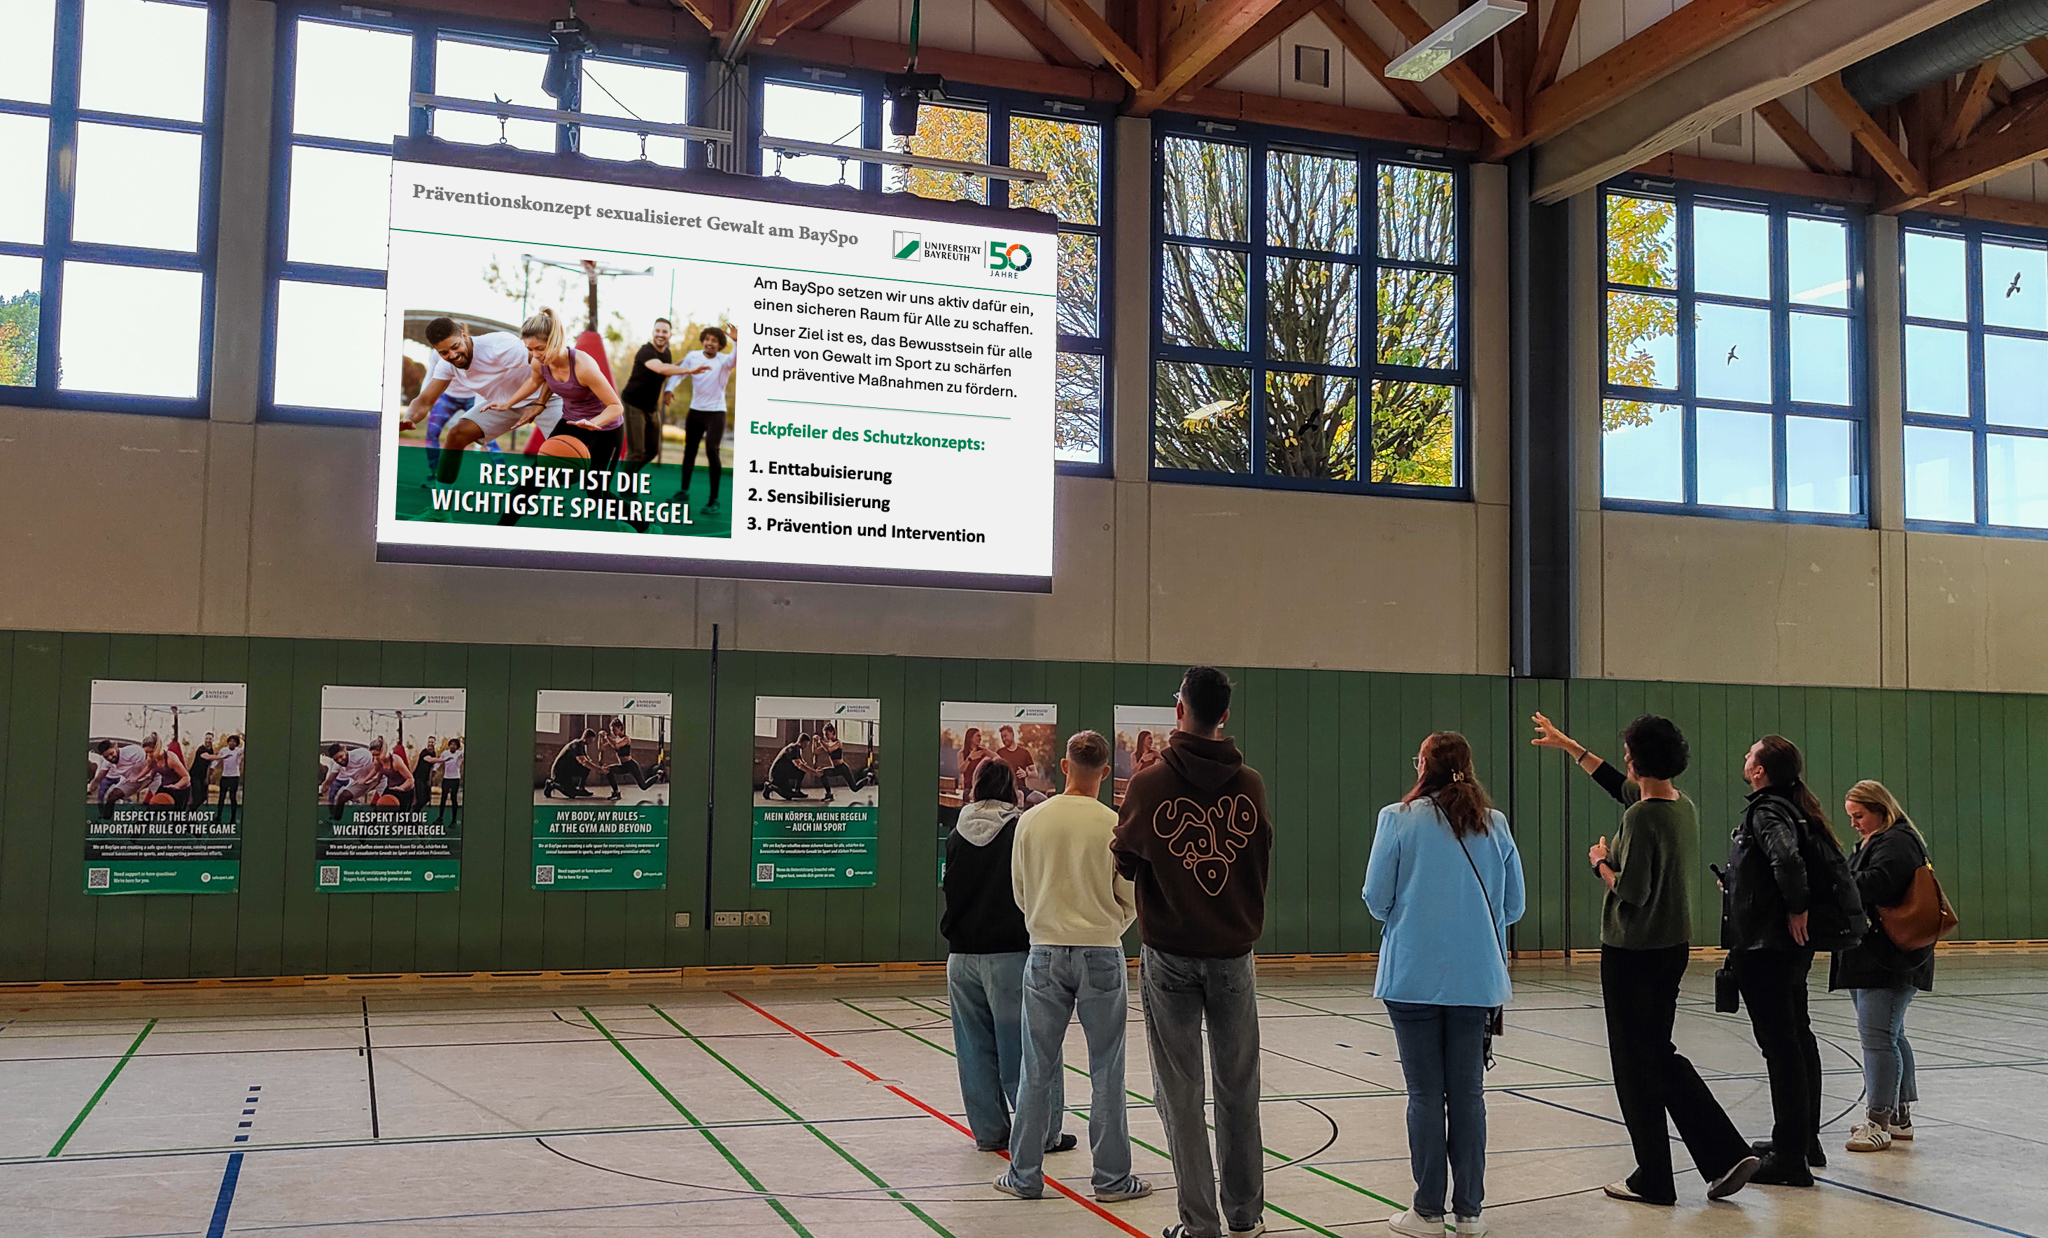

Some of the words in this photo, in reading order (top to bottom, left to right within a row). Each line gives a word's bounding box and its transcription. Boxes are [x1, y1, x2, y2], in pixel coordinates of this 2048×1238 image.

[412, 183, 591, 219] Präventionskonzept
[596, 208, 701, 228] sexualisieret
[706, 216, 764, 234] Gewalt
[768, 226, 794, 238] am
[798, 226, 858, 247] BaySpo
[924, 242, 981, 254] UNIVERSITÄT
[924, 250, 970, 262] BAYREUTH
[990, 241, 1032, 271] 50
[990, 270, 1018, 279] JAHRE
[754, 276, 777, 289] Am
[782, 279, 834, 296] BaySpo
[838, 287, 882, 300] setzen
[886, 290, 906, 302] wir
[910, 294, 934, 305] uns
[938, 295, 969, 308] aktiv
[972, 298, 1006, 312] dafür
[1010, 302, 1033, 316] ein,
[754, 298, 792, 312] einen
[796, 302, 855, 318] sicheren
[860, 307, 899, 322] Raum
[903, 311, 922, 324] für
[924, 314, 950, 327] Alle
[953, 319, 968, 328] zu
[972, 320, 1032, 334] schaffen.
[753, 322, 795, 337] Unser
[798, 326, 823, 340] Ziel
[827, 329, 843, 342] ist
[847, 334, 866, 346] es,
[871, 334, 895, 346] das
[899, 336, 983, 354] Bewusstsein
[987, 344, 1005, 356] für
[1008, 346, 1032, 359] alle
[751, 343, 789, 357] Arten
[793, 349, 818, 360] von
[822, 349, 871, 364] Gewalt
[875, 354, 891, 366] im
[895, 355, 931, 370] Sport
[935, 362, 950, 371] zu
[954, 362, 1011, 376] schärfen
[752, 366, 778, 377] und
[783, 368, 854, 384] präventive
[858, 373, 943, 391] Maßnahmen
[946, 383, 961, 392] zu
[965, 382, 1016, 397] fördern.
[750, 421, 828, 439] Eckpfeiler
[832, 426, 858, 441] des
[863, 429, 984, 452] Schutzkonzepts:
[480, 463, 573, 488] RESPEKT
[579, 469, 610, 490] IST
[617, 472, 650, 493] DIE
[749, 460, 762, 473] 1.
[768, 461, 892, 484] Enttabuisierung
[431, 488, 563, 516] WICHTIGSTE
[570, 497, 692, 524] SPIELREGEL
[748, 488, 762, 501] 2.
[767, 489, 890, 512] Sensibilisierung
[747, 516, 761, 530] 3.
[767, 518, 851, 535] Prävention
[857, 524, 886, 537] und
[892, 525, 984, 542] Intervention
[113, 811, 155, 820] RESPECT
[157, 811, 166, 820] IS
[168, 811, 186, 820] THE
[188, 811, 214, 821] MOST
[353, 812, 393, 822] RESPEKT
[395, 812, 409, 822] IST
[412, 812, 426, 822] DIE
[549, 823, 559, 832] AT
[561, 823, 577, 832] THE
[579, 823, 597, 832] GYM
[599, 823, 616, 832] AND
[618, 823, 651, 832] BEYOND
[556, 811, 569, 820] MY
[571, 811, 595, 822] BODY,
[597, 811, 610, 820] MY
[612, 811, 637, 820] RULES
[764, 812, 783, 820] MEIN
[784, 811, 814, 821] KÖRPER,
[816, 812, 838, 820] MEINE
[840, 812, 866, 820] REGELN
[792, 823, 811, 831] AUCH
[813, 822, 822, 831] IM
[823, 822, 846, 831] SPORT
[90, 824, 146, 833] IMPORTANT
[149, 824, 173, 833] RULE
[175, 824, 187, 833] OF
[189, 824, 206, 833] THE
[209, 824, 235, 833] GAME
[333, 825, 389, 835] WICHTIGSTE
[392, 825, 445, 835] SPIELREGEL
